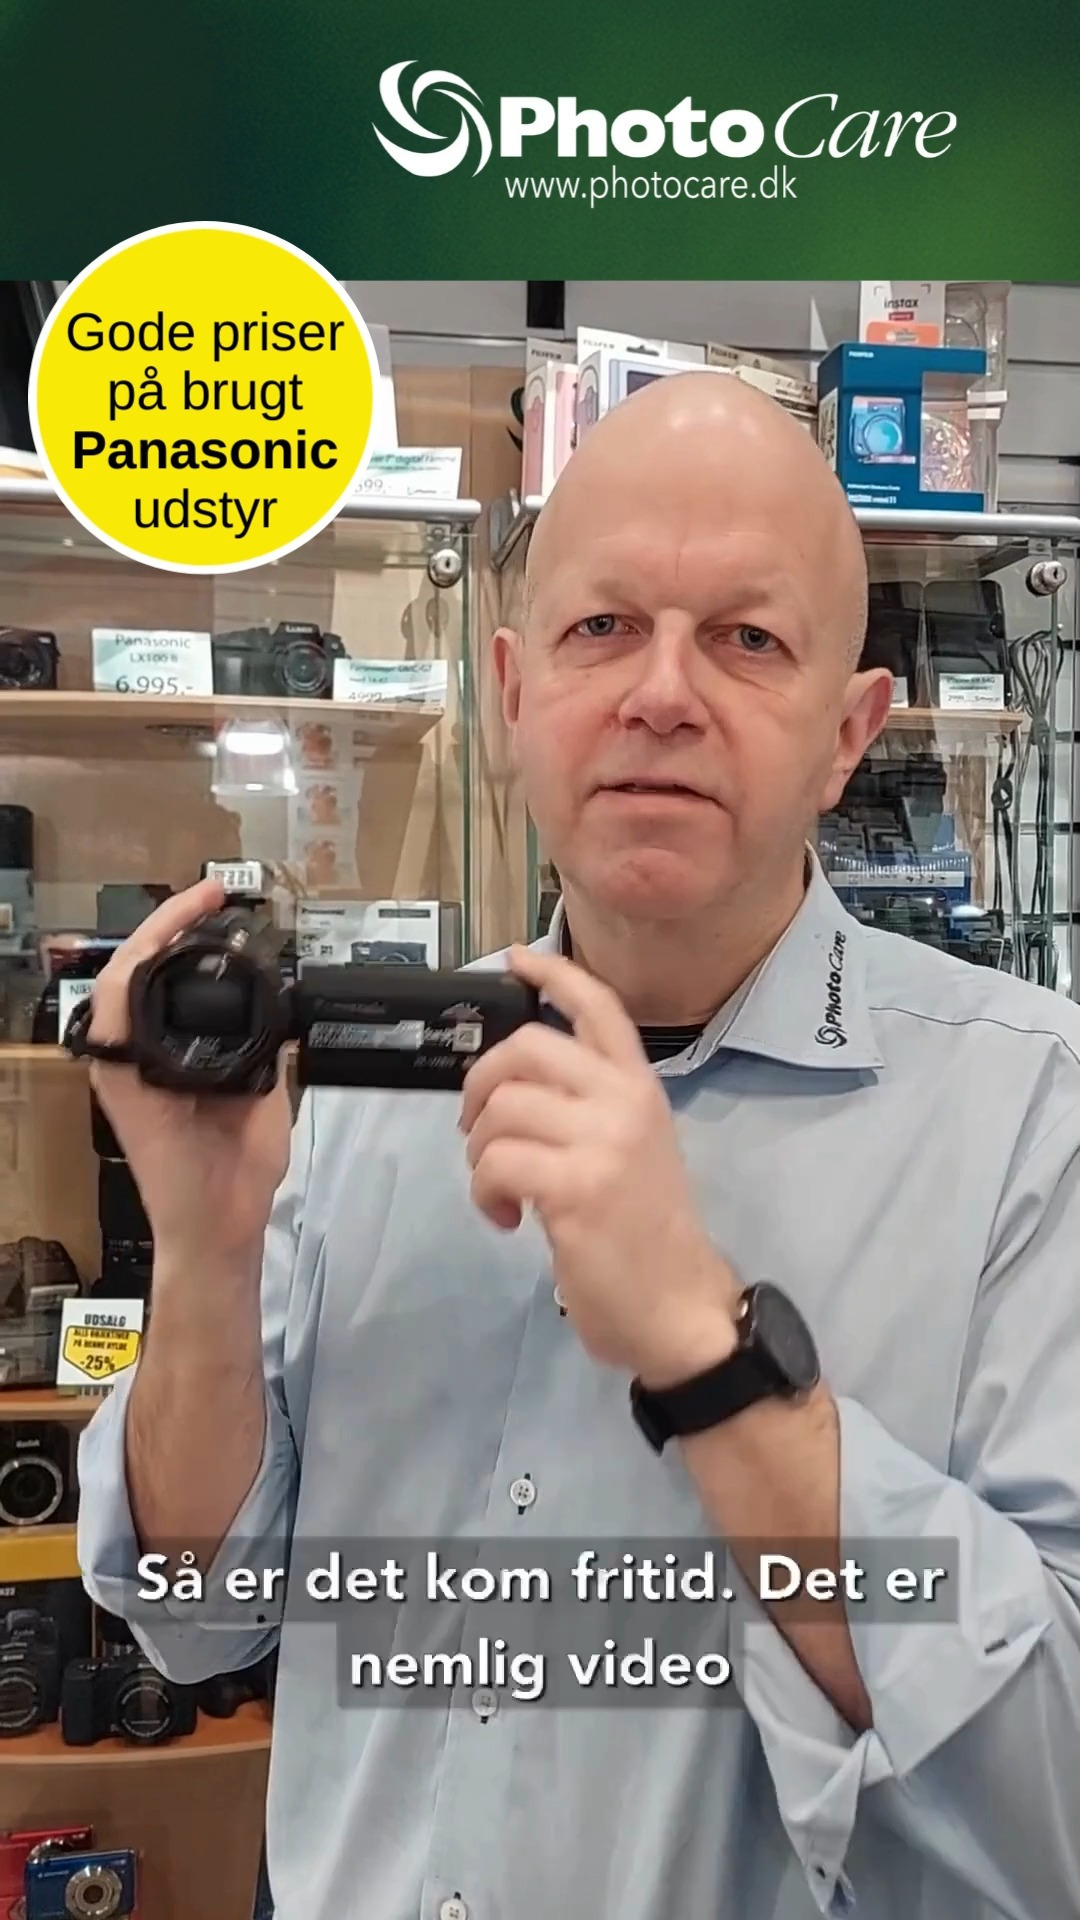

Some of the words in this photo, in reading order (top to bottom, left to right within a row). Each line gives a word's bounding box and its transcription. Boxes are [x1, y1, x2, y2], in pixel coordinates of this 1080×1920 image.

[884, 297, 919, 309] instax
[115, 633, 192, 649] Panasonic
[115, 674, 194, 696] 6.995,-
[84, 1314, 127, 1327] UDSALG
[84, 1341, 106, 1349] DENNE
[106, 1341, 128, 1351] HYLDE
[80, 1355, 116, 1372] -25%
